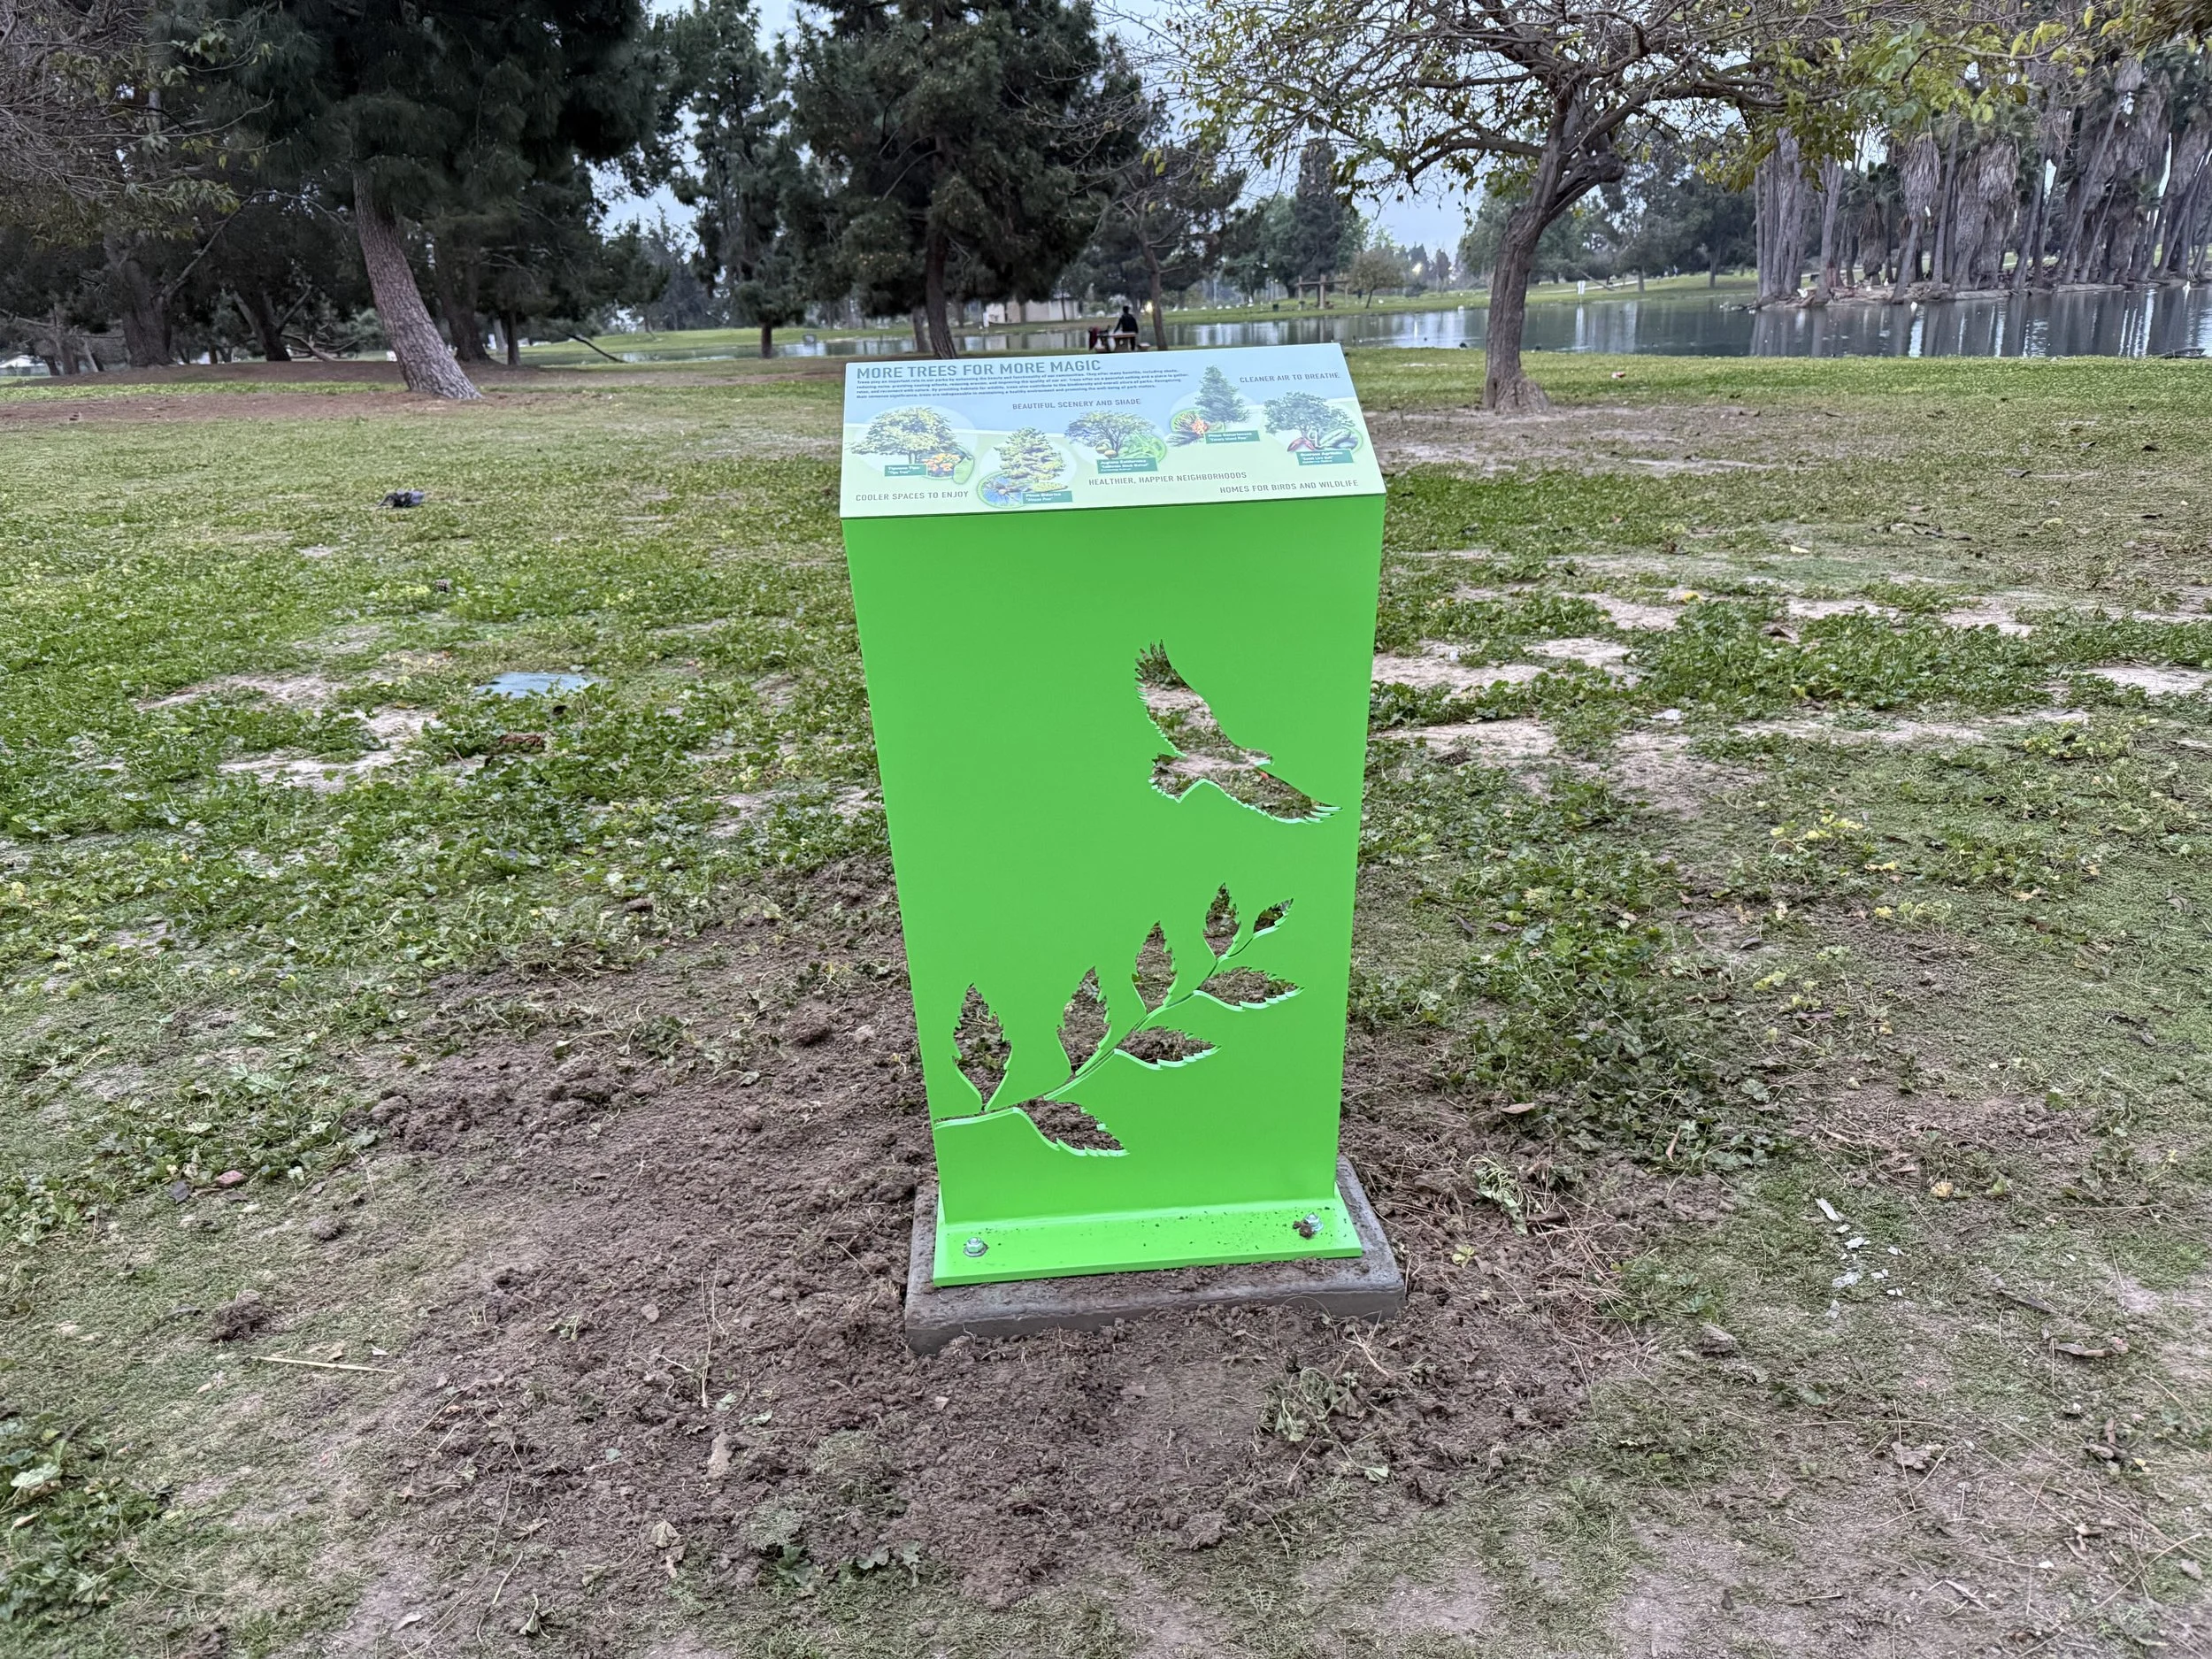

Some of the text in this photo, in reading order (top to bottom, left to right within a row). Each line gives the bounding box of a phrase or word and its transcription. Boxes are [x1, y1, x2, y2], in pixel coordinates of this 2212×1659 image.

[857, 360, 1101, 379] MORE TREES FOR MORE MAGIC
[1089, 477, 1136, 485] HEALTHIER,
[1177, 472, 1247, 482] NEIGHBORHOODS
[1220, 485, 1249, 493] HOMES
[1319, 480, 1358, 488] WILDLIFE
